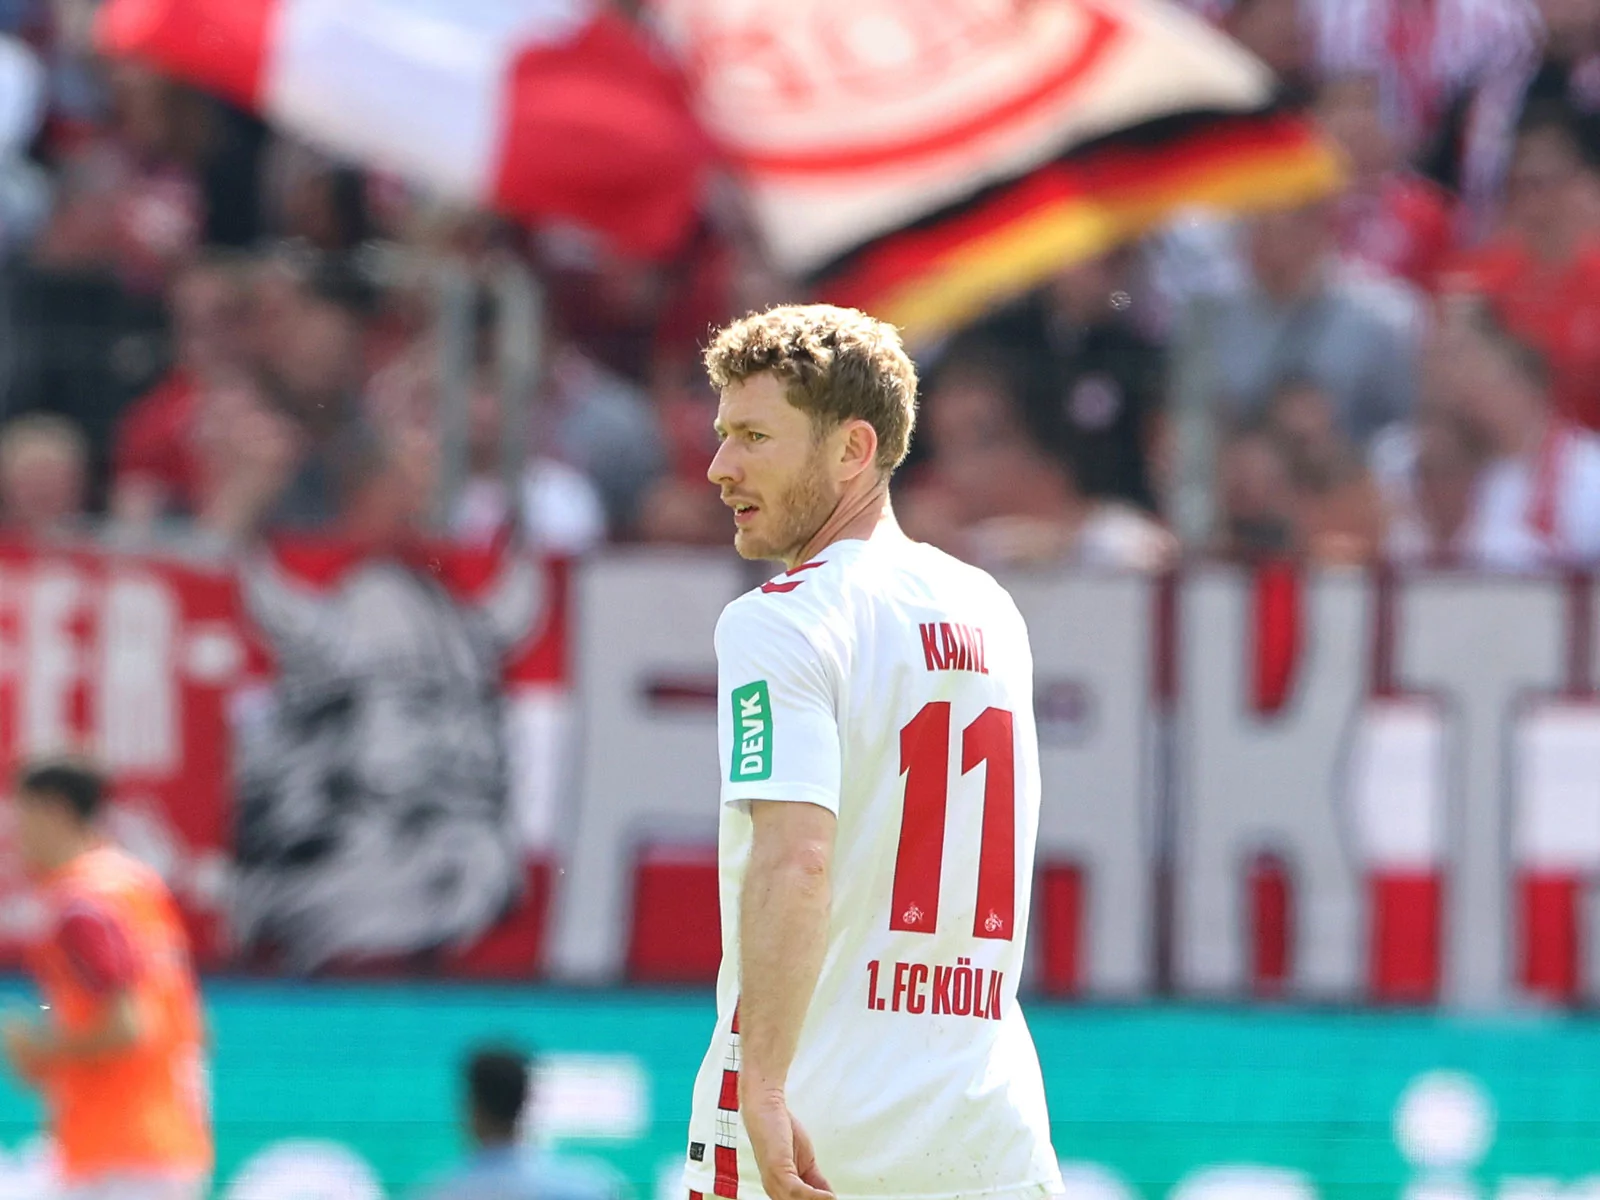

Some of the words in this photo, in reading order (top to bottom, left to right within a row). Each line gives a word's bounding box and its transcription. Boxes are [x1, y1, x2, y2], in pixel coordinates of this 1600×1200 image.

[919, 621, 989, 675] KAINZ
[738, 690, 765, 775] DEVK
[889, 700, 1016, 942] 11
[867, 960, 885, 1010] 1.
[891, 963, 929, 1016] FC
[931, 957, 1003, 1021] KÖLN
